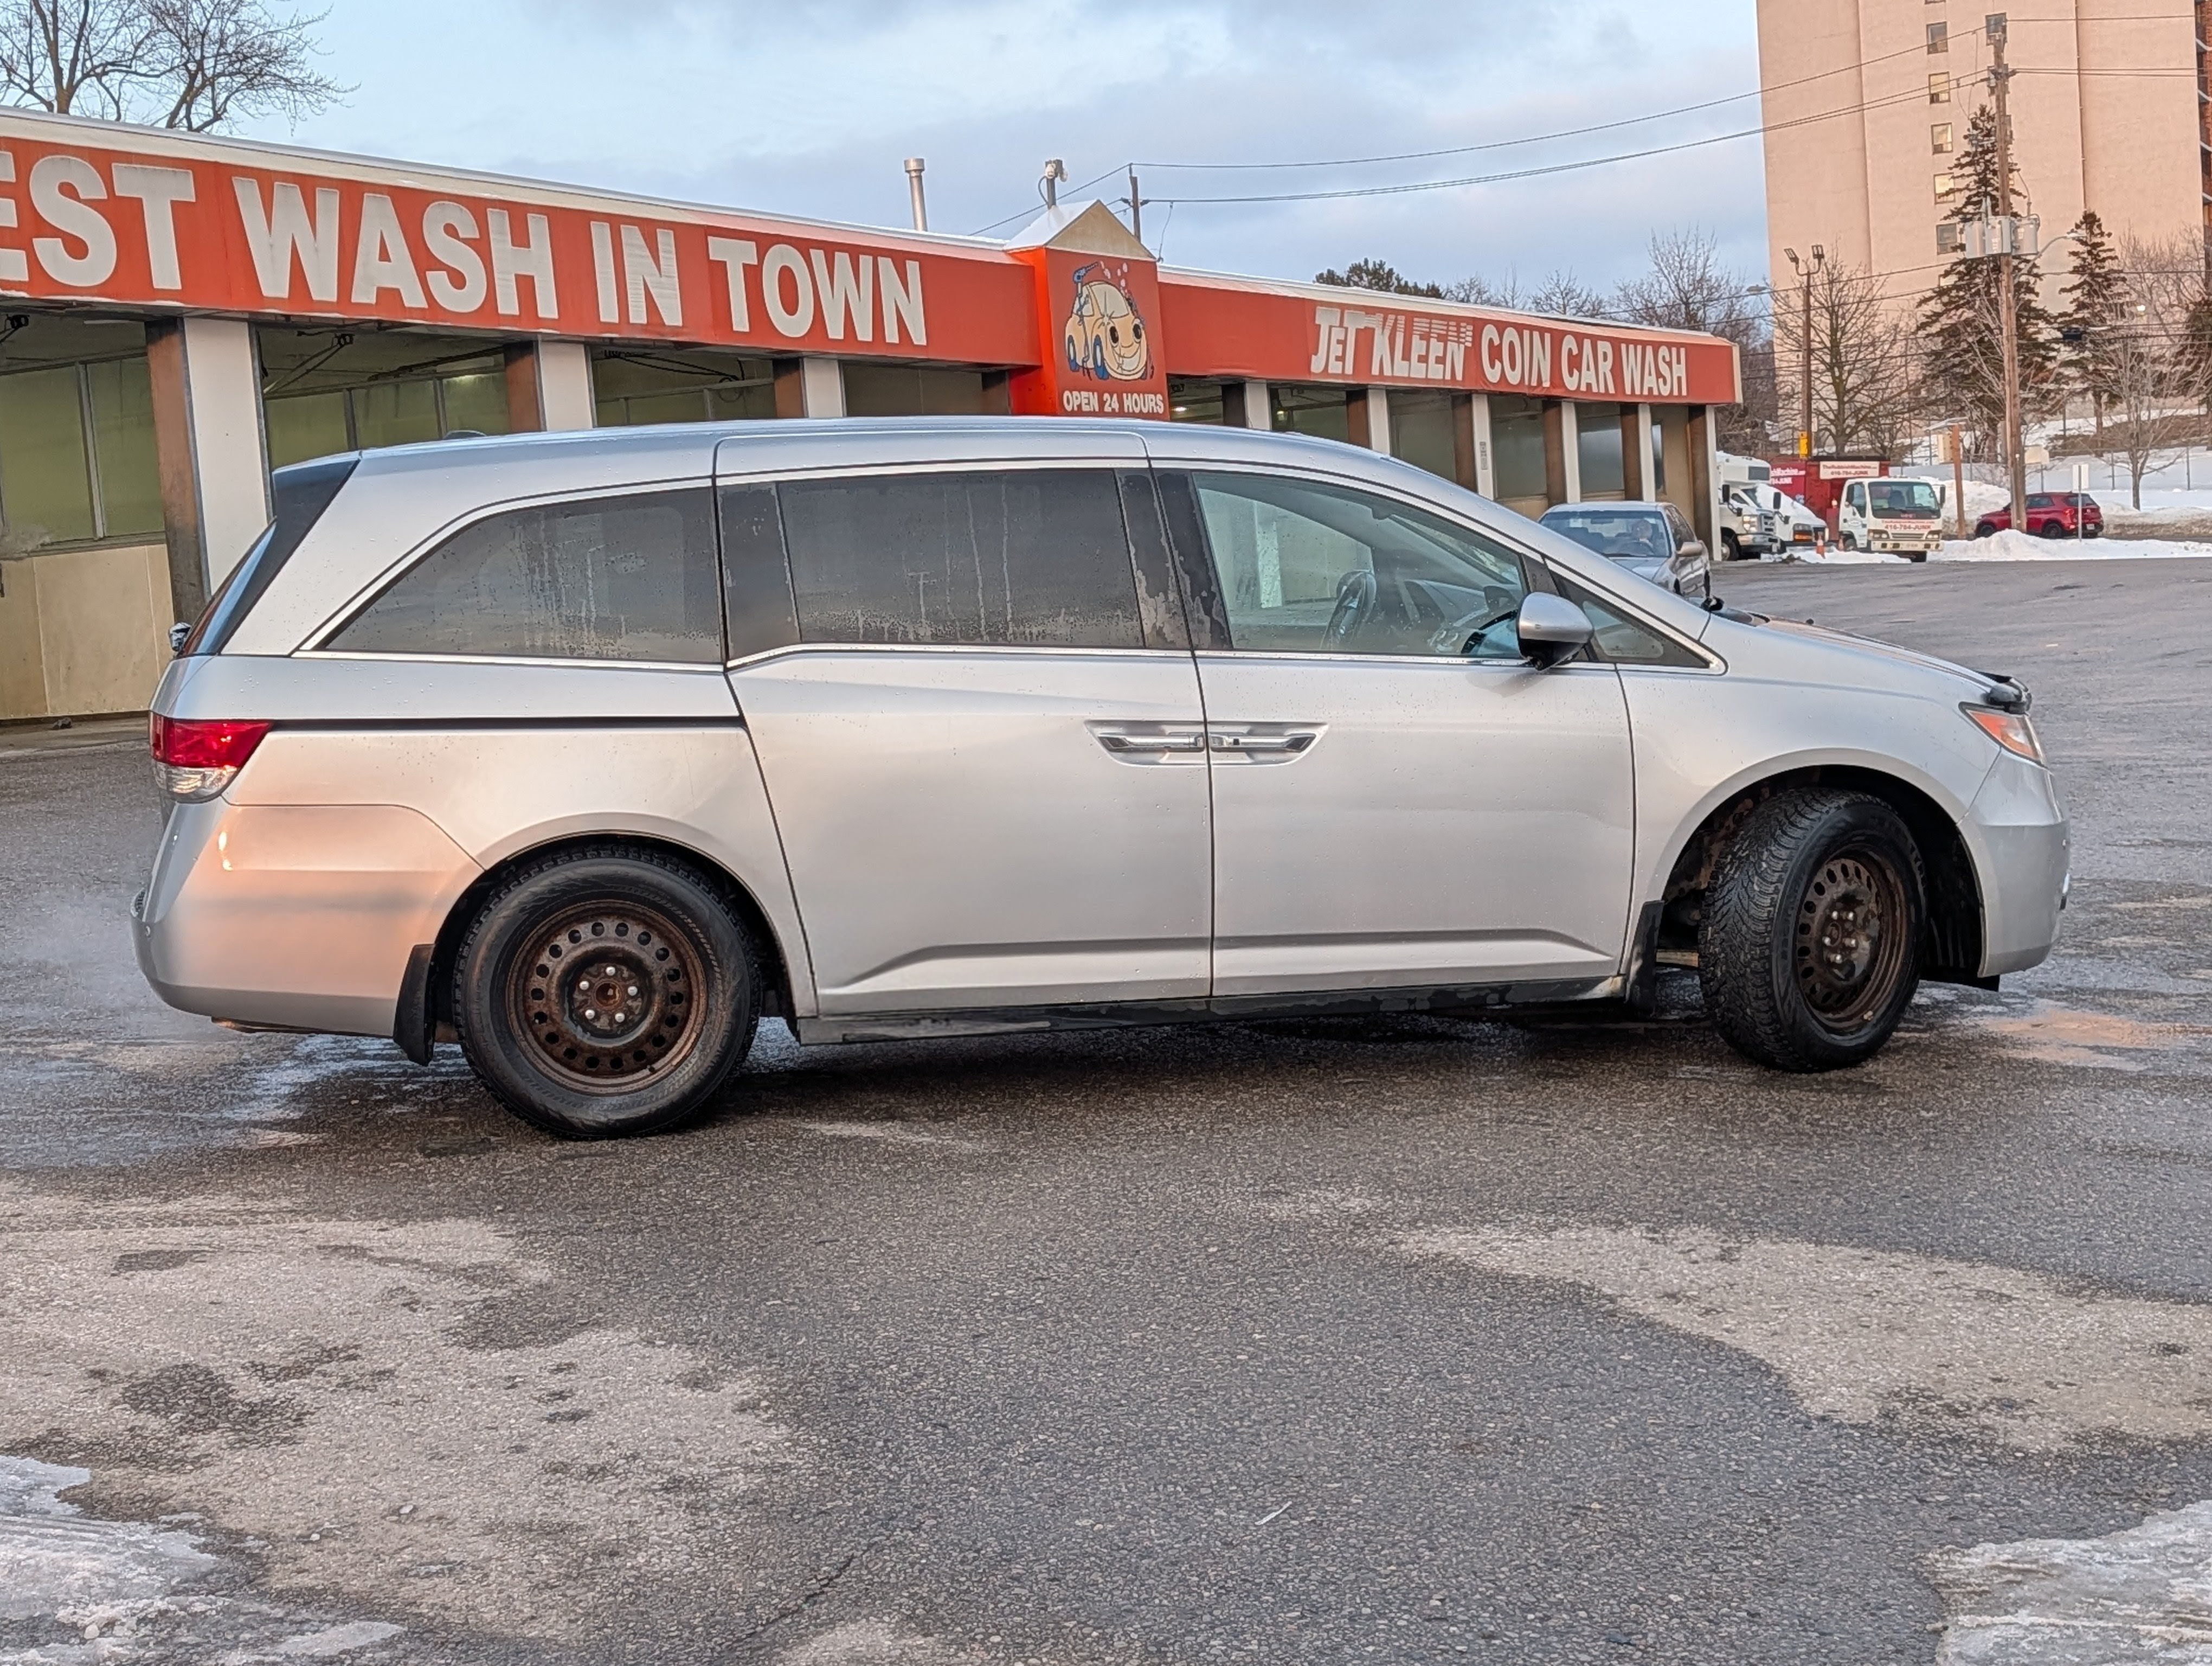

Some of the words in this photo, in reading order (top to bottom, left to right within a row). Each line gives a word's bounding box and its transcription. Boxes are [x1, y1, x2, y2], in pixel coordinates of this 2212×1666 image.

[232, 177, 559, 319] WASH
[590, 221, 683, 326] IN
[708, 235, 927, 346] TOWN
[1310, 306, 1366, 375] JET
[1371, 313, 1473, 381] KLEEN
[1481, 324, 1551, 388] COIN
[1561, 335, 1616, 394] CAR
[1621, 343, 1687, 396] WASH
[1063, 390, 1099, 412] OPEN
[1103, 393, 1120, 413] 24
[1123, 393, 1164, 414] HOURS
